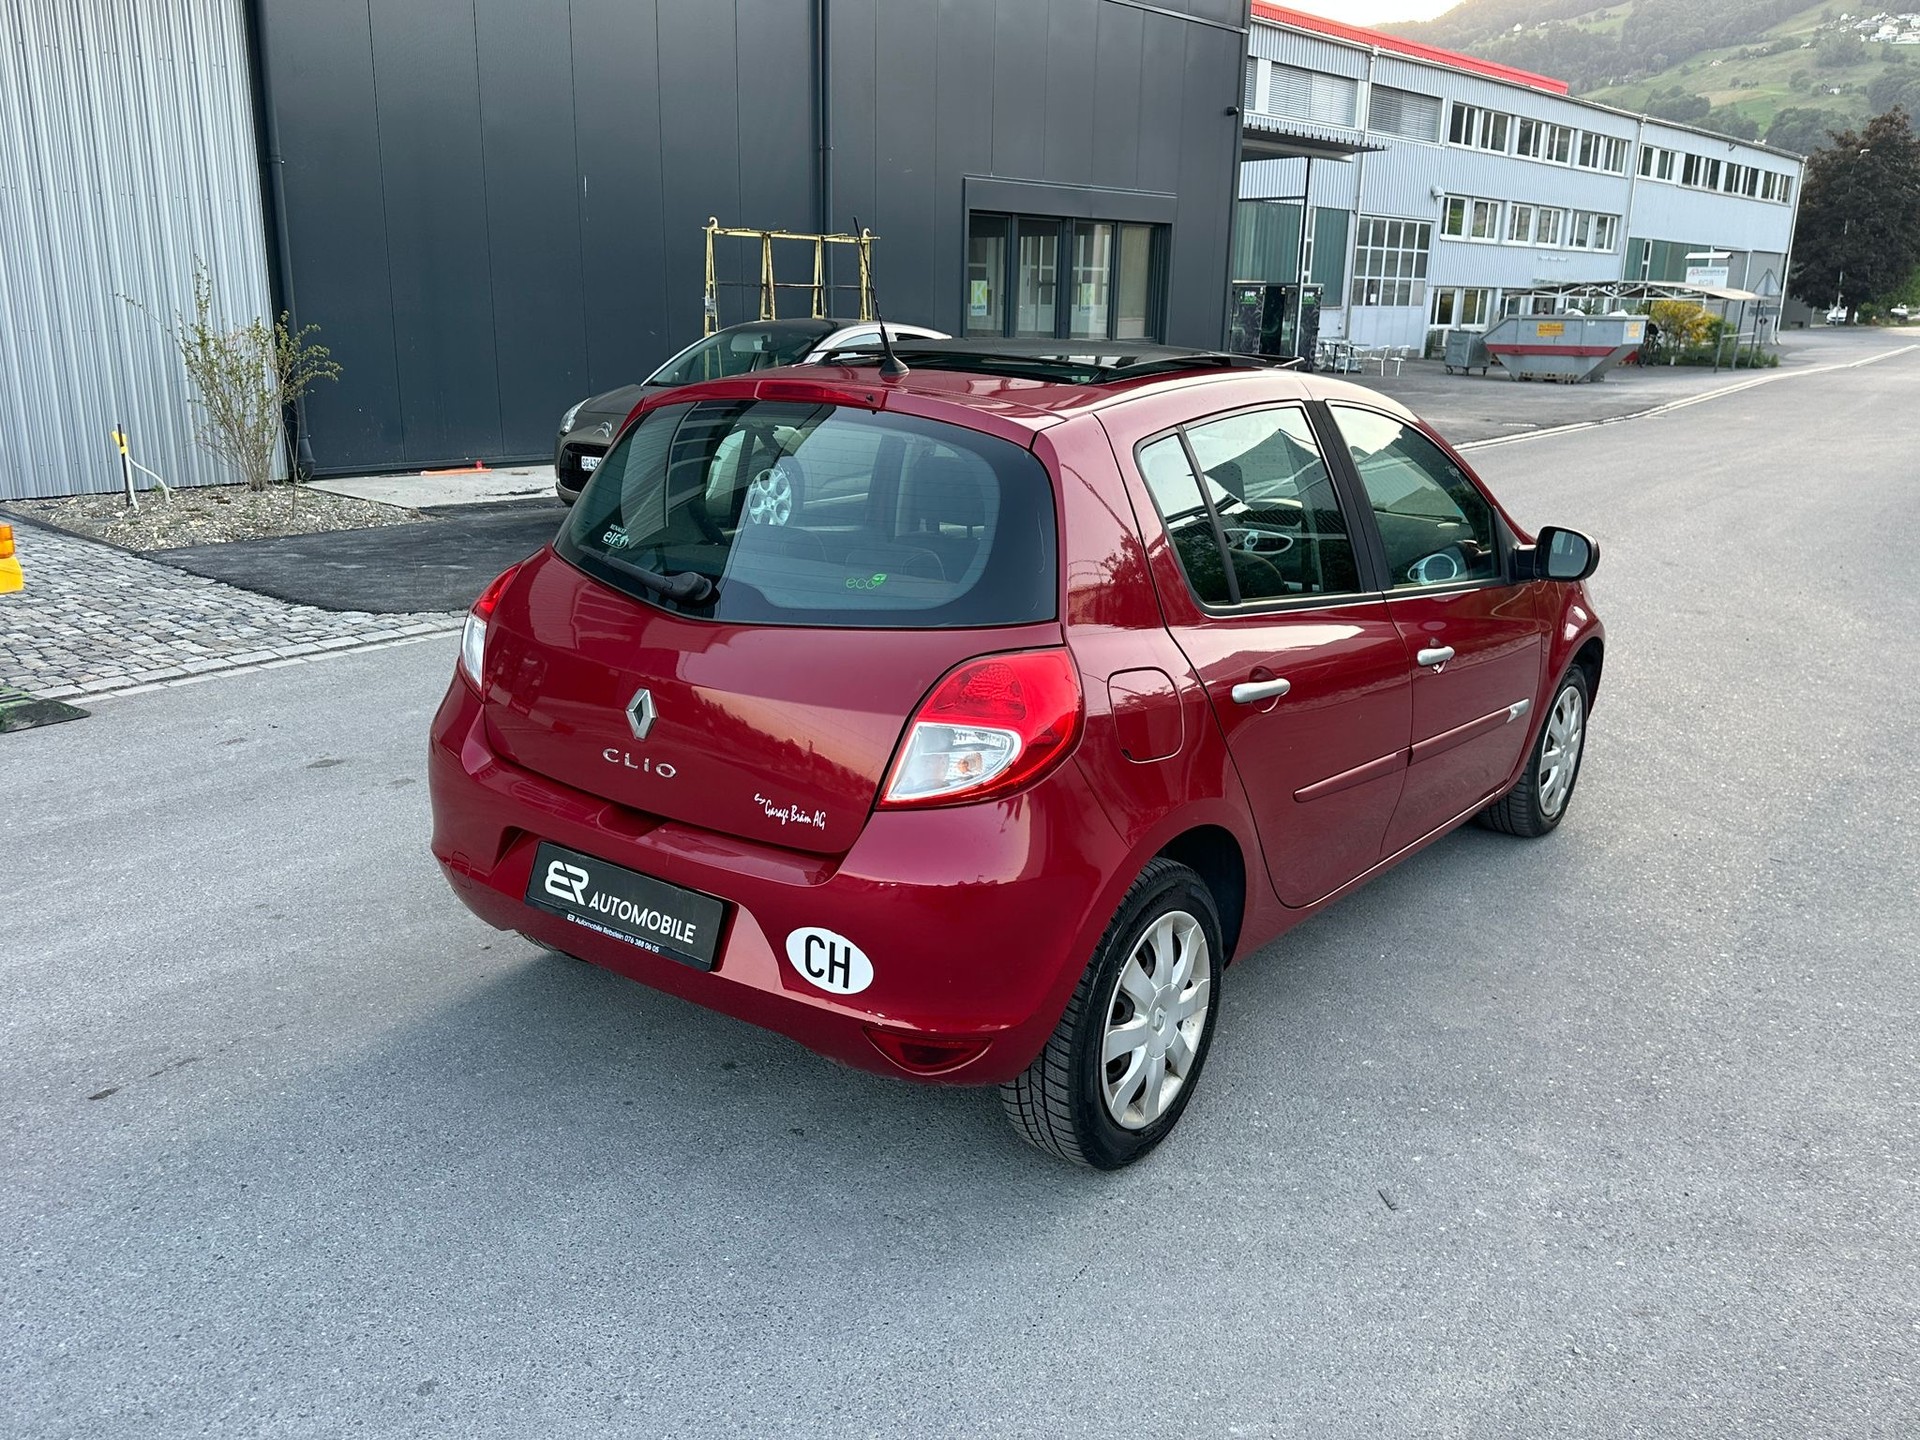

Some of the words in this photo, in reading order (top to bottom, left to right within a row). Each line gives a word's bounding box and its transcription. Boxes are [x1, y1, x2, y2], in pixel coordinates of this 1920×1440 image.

[603, 531, 621, 545] elf
[846, 576, 880, 590] eco
[602, 748, 677, 779] CLIO
[812, 810, 827, 831] AG
[545, 860, 589, 906] ER
[588, 890, 697, 945] AUTOMOBILE
[575, 917, 603, 932] Automobile
[602, 926, 624, 940] Rebstein
[624, 934, 635, 944] 076
[645, 942, 652, 951] 06
[652, 945, 660, 954] 05
[804, 934, 851, 989] CH
